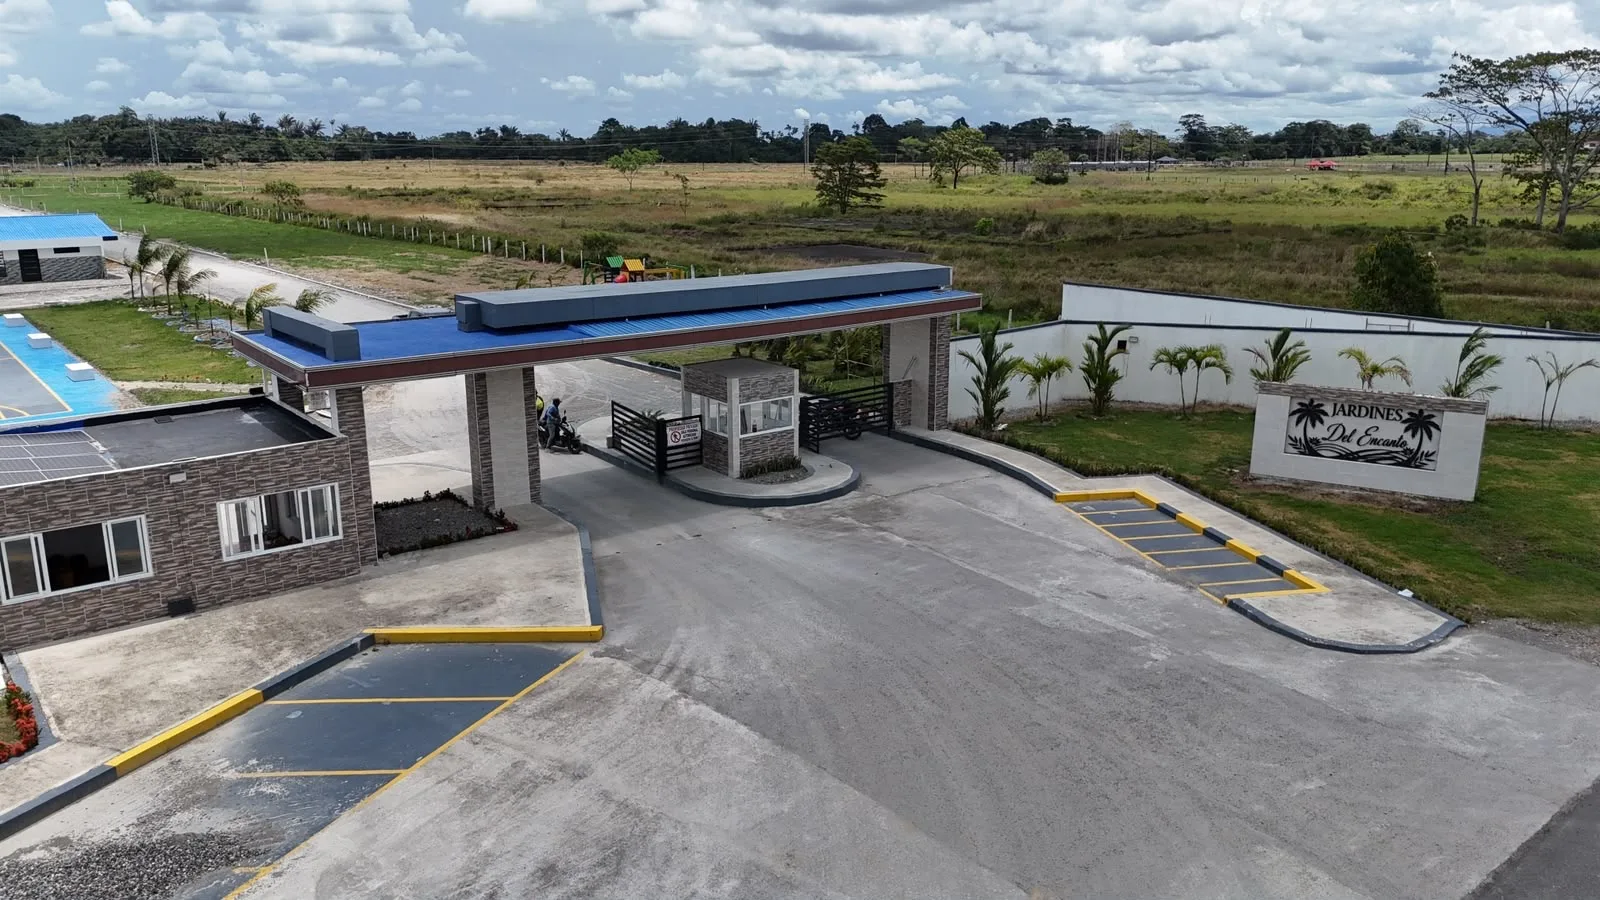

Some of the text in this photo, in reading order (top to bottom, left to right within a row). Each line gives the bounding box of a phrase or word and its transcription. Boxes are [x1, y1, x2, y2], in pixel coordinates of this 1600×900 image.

[1331, 403, 1403, 421] JARDINES
[1322, 423, 1407, 448] Del Encanto
